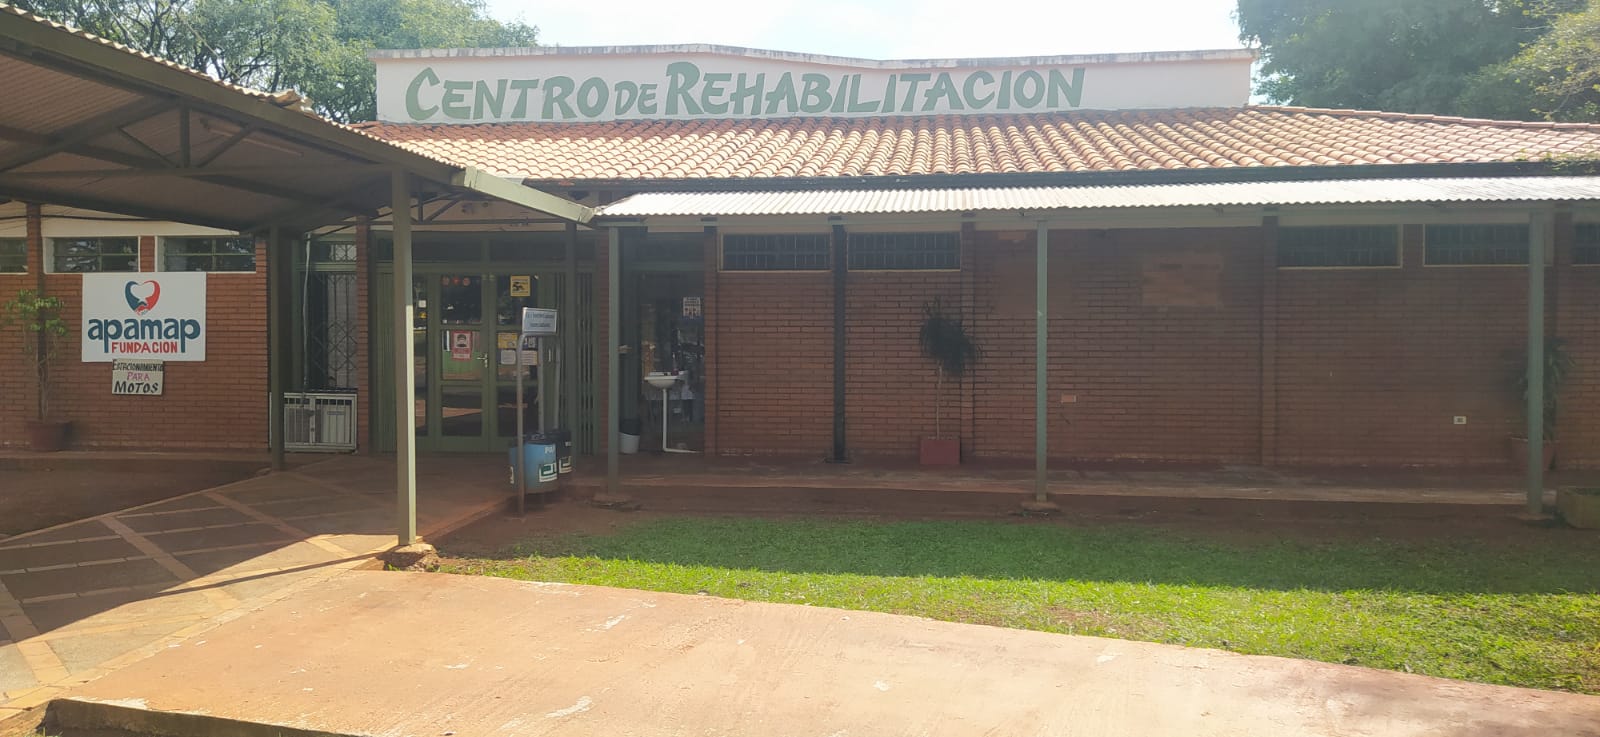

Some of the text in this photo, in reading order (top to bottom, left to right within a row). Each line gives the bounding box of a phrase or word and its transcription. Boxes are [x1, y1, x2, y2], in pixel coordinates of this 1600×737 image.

[405, 61, 1086, 121] CENTRO DE REHABILITACION
[87, 318, 201, 353] apamap
[111, 341, 178, 354] FUNDACION
[127, 371, 150, 381] PARA
[114, 380, 159, 393] MOTOS
